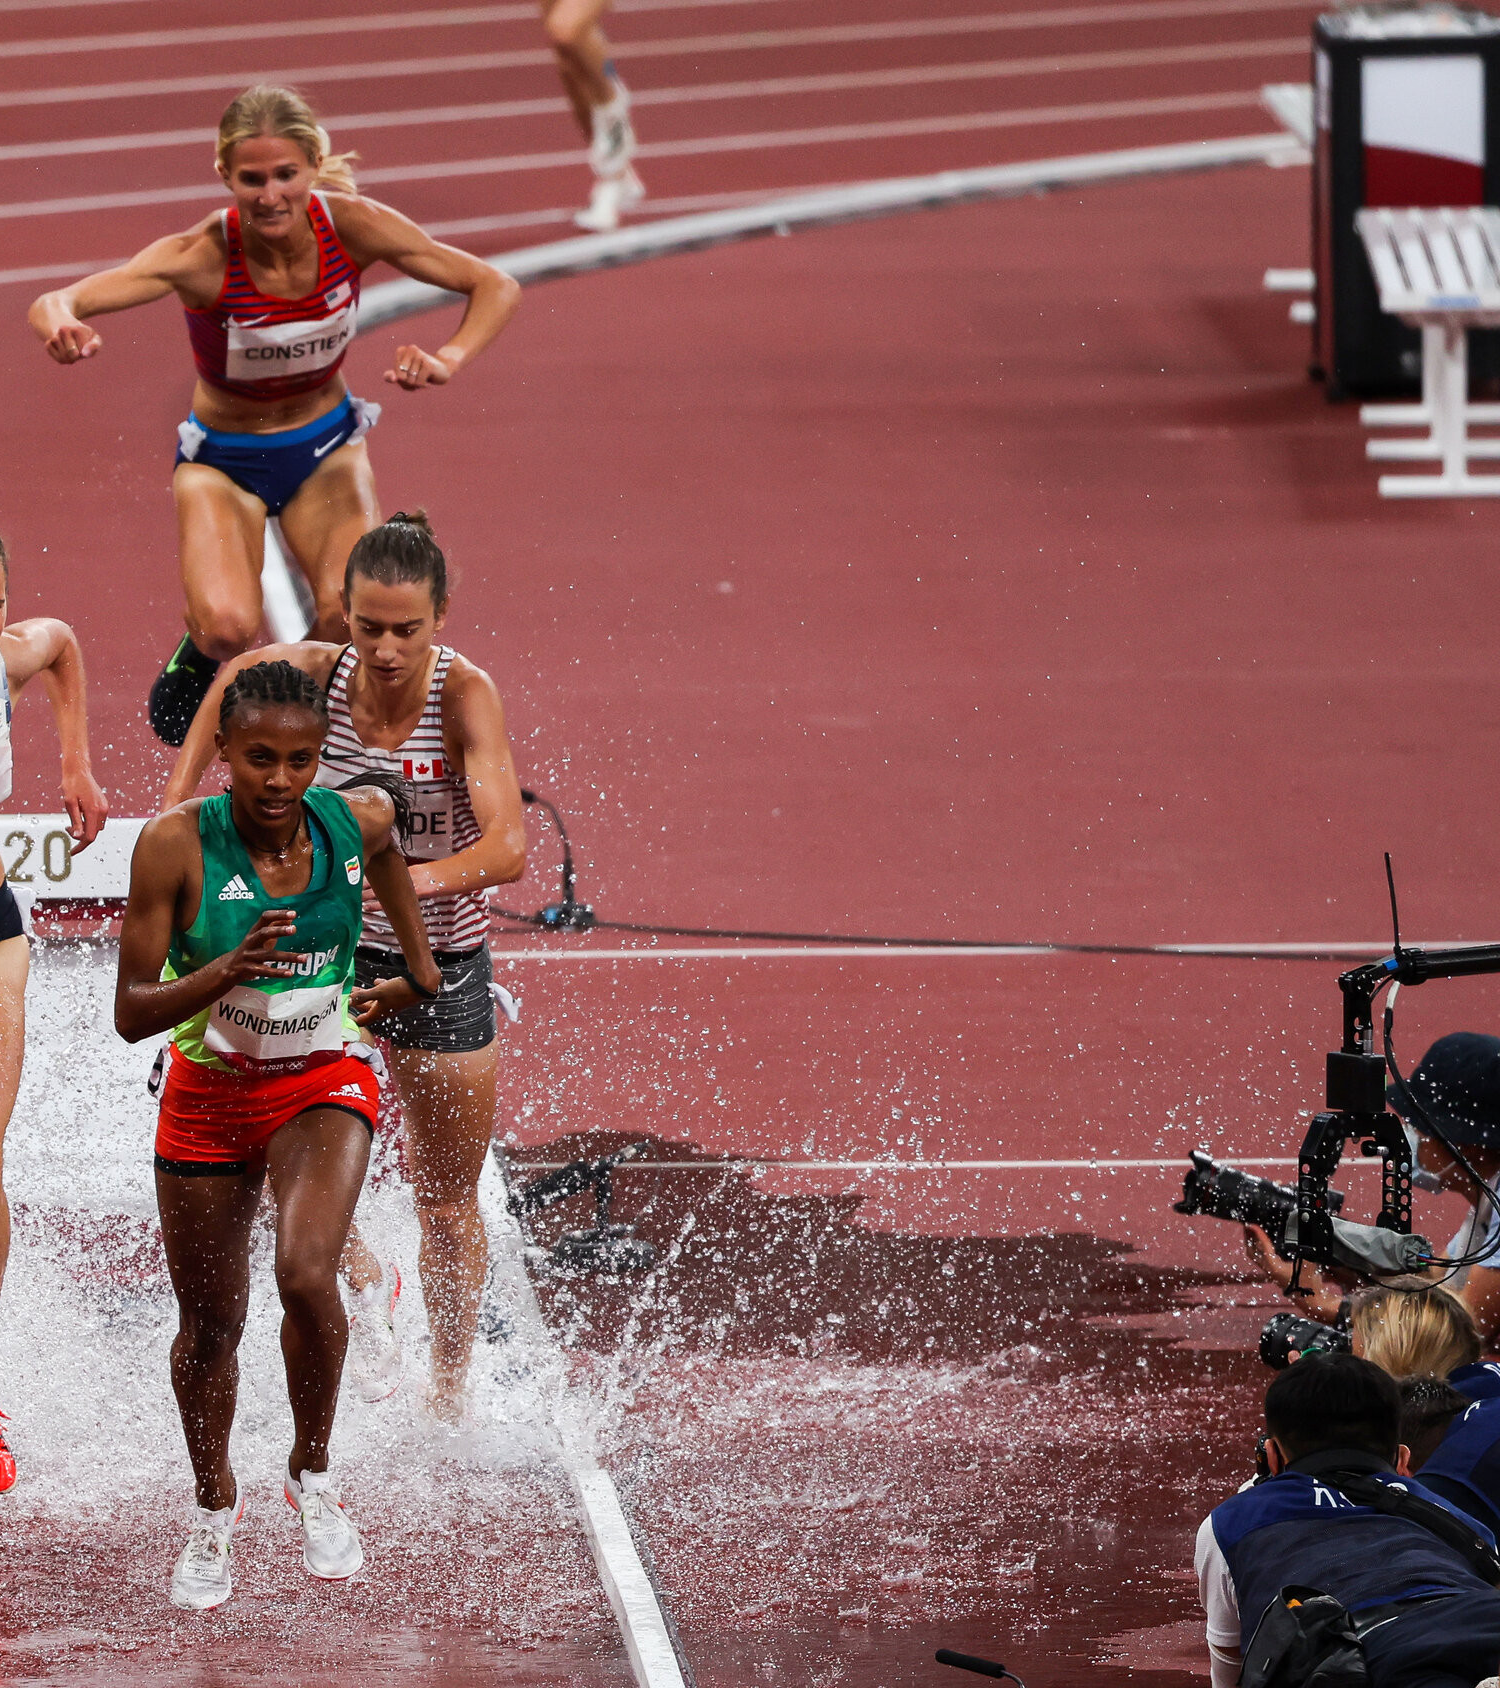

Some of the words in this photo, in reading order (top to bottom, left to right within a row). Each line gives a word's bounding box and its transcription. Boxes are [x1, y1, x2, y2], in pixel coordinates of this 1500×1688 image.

[244, 326, 349, 360] CONSTIEN
[4, 830, 72, 883] 20
[218, 890, 255, 901] adidas
